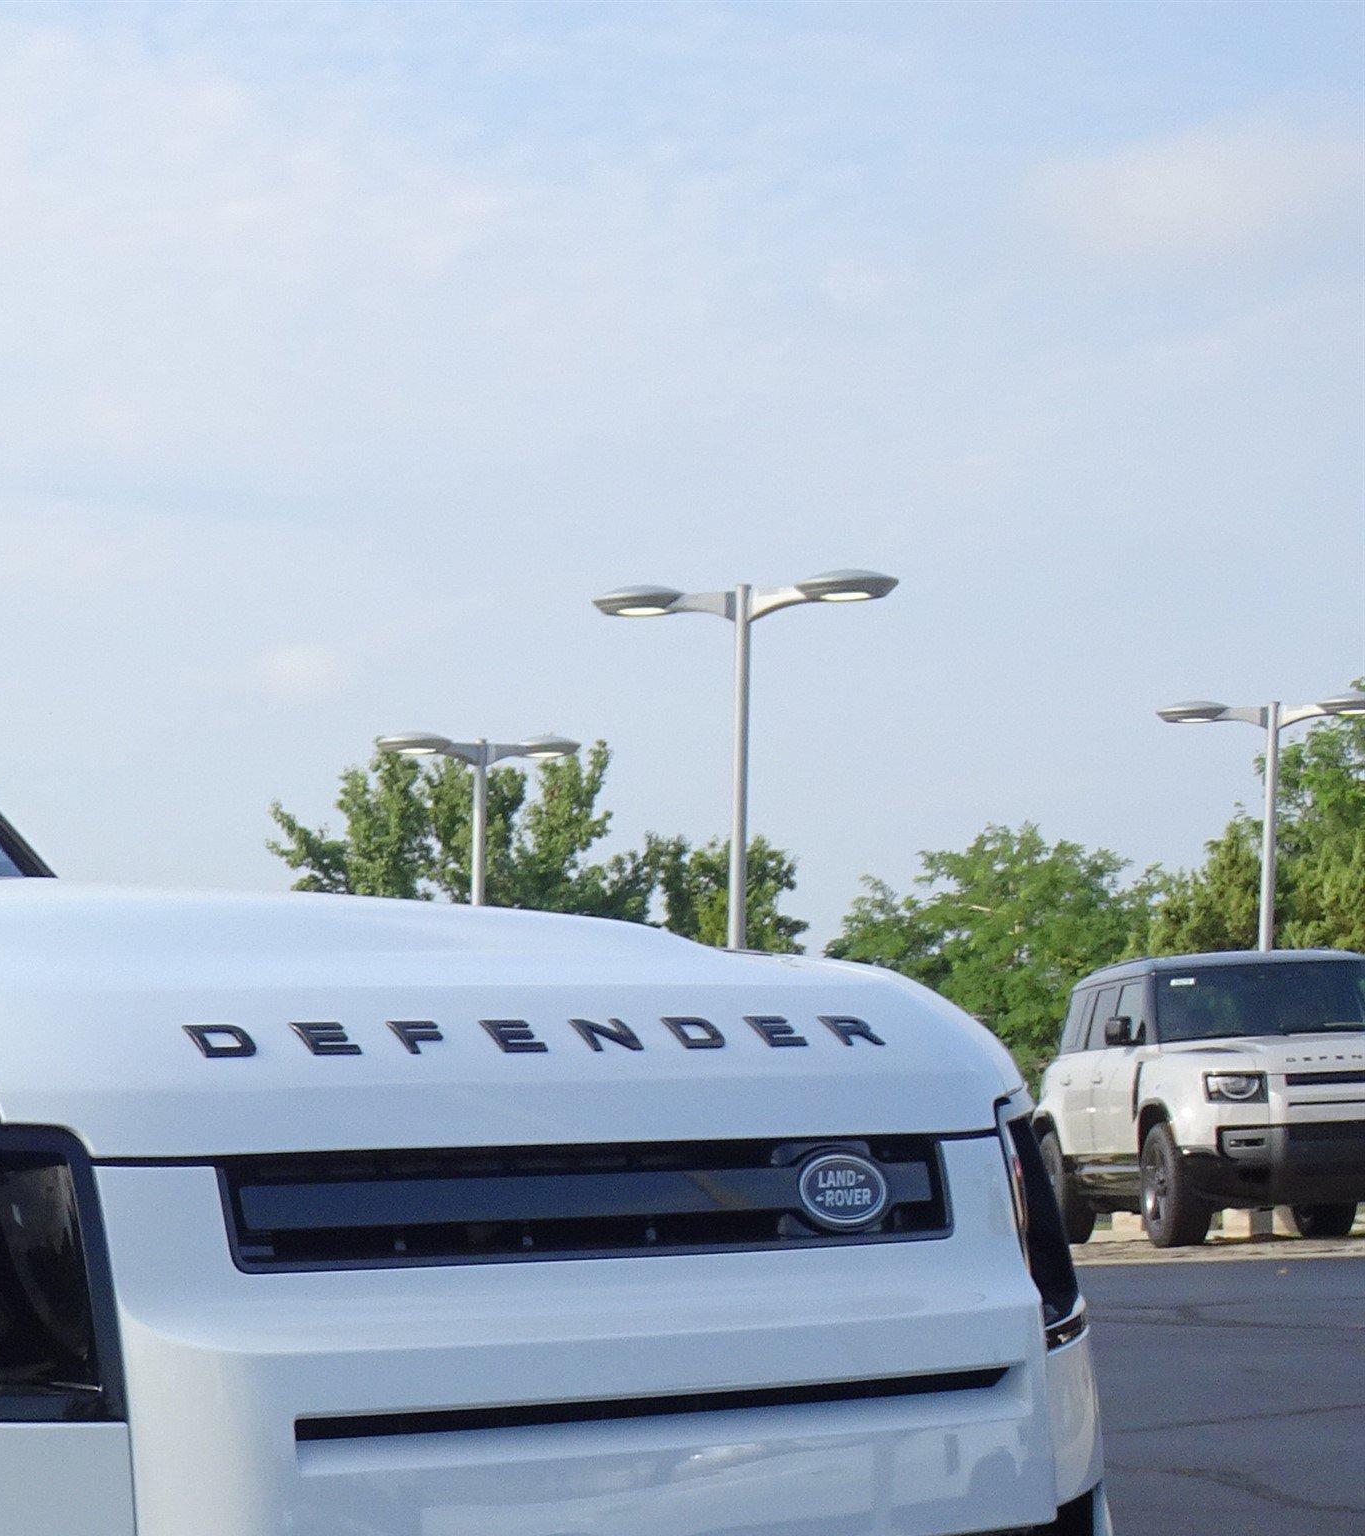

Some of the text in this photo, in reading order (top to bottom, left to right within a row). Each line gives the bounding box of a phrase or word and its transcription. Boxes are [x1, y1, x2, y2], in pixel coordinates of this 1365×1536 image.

[181, 1015, 887, 1058] DEFENDER
[817, 1169, 857, 1188] LAND
[824, 1187, 872, 1207] ROVER
